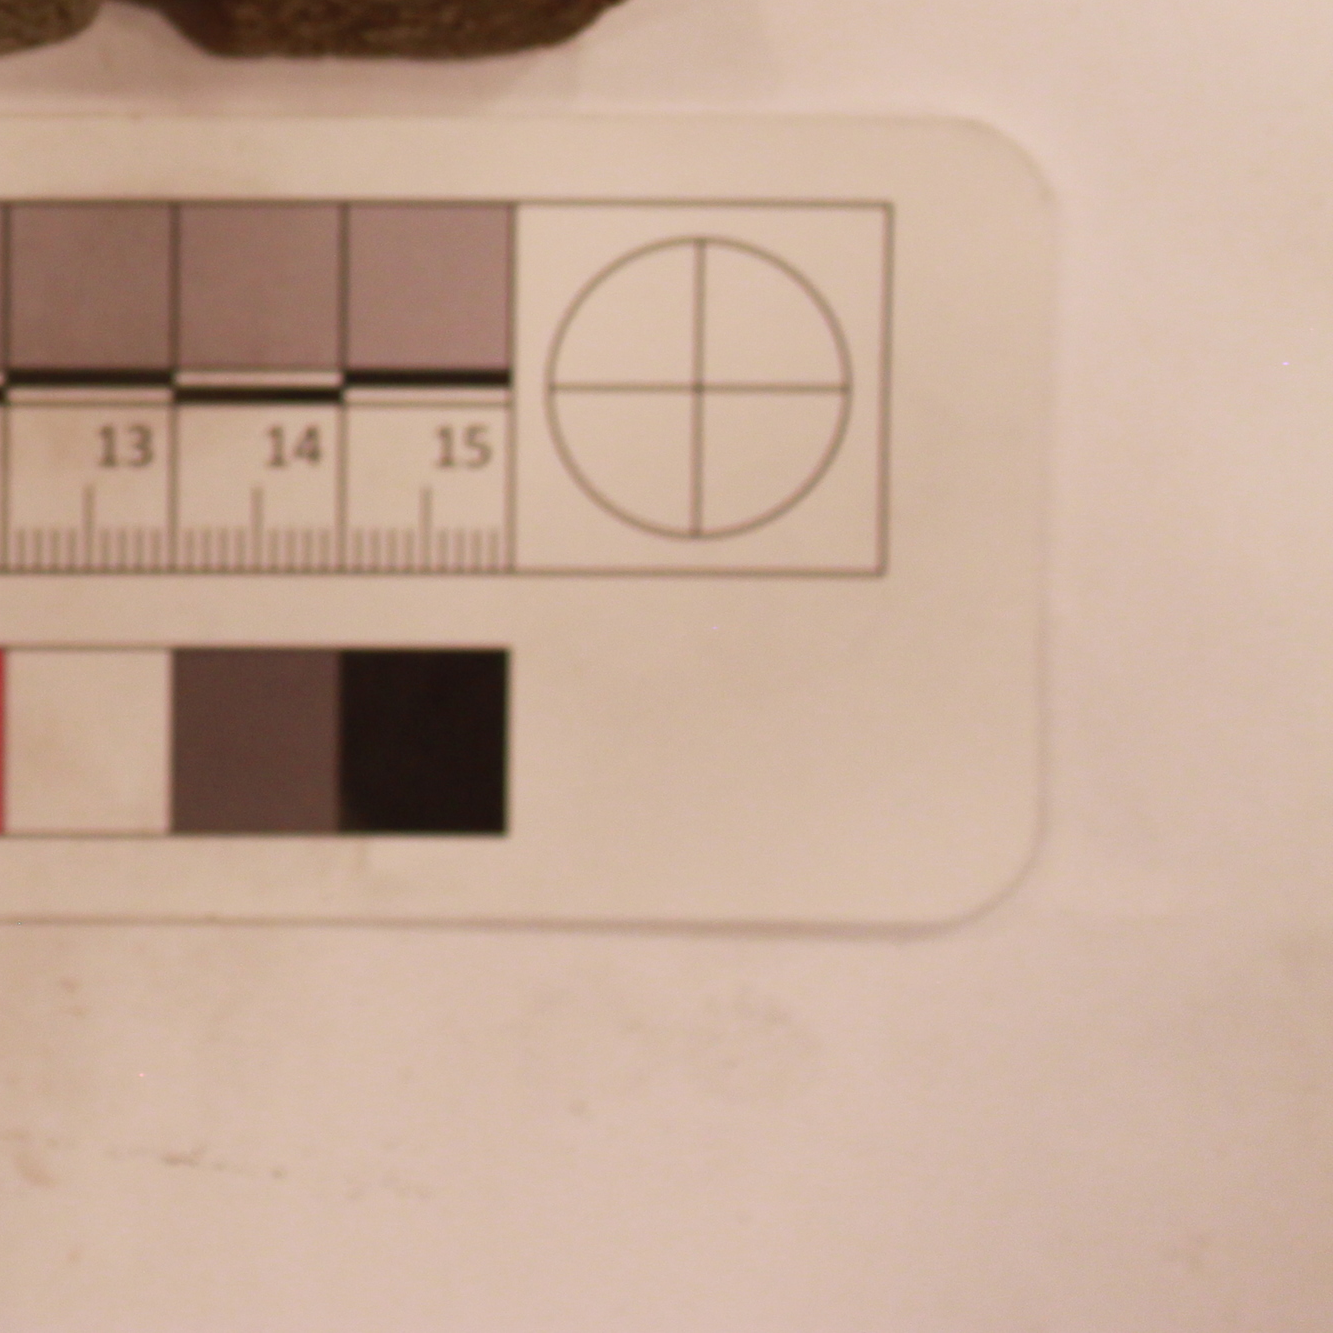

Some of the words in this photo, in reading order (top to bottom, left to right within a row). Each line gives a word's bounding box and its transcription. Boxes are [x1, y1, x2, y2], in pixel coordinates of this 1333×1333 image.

[99, 424, 153, 468] 13
[268, 425, 322, 469] 14
[437, 425, 492, 469] 15
